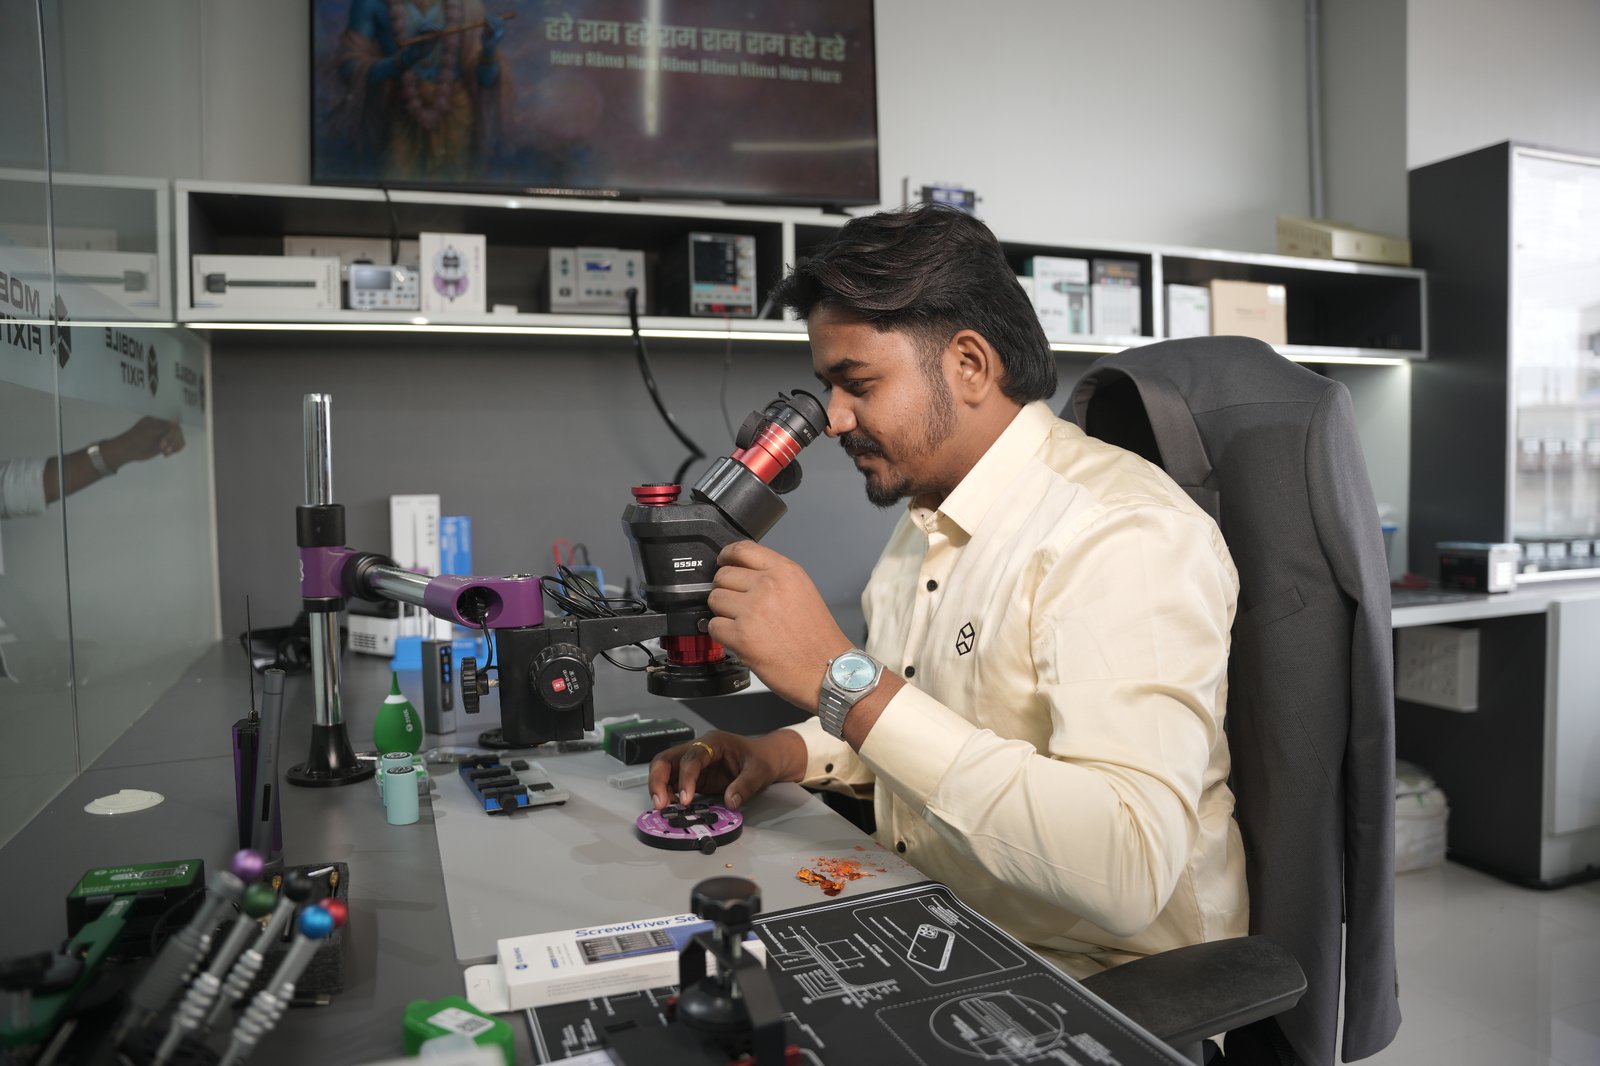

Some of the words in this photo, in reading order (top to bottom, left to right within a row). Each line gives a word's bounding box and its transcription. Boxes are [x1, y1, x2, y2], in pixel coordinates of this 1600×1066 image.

[545, 12, 574, 42] हरे
[577, 18, 621, 45] राम
[656, 24, 698, 49] राम
[701, 28, 742, 53] राम
[745, 31, 786, 57] राम
[787, 30, 816, 59] हरे
[817, 33, 846, 62] हरे
[575, 919, 673, 937] Screwdriver
